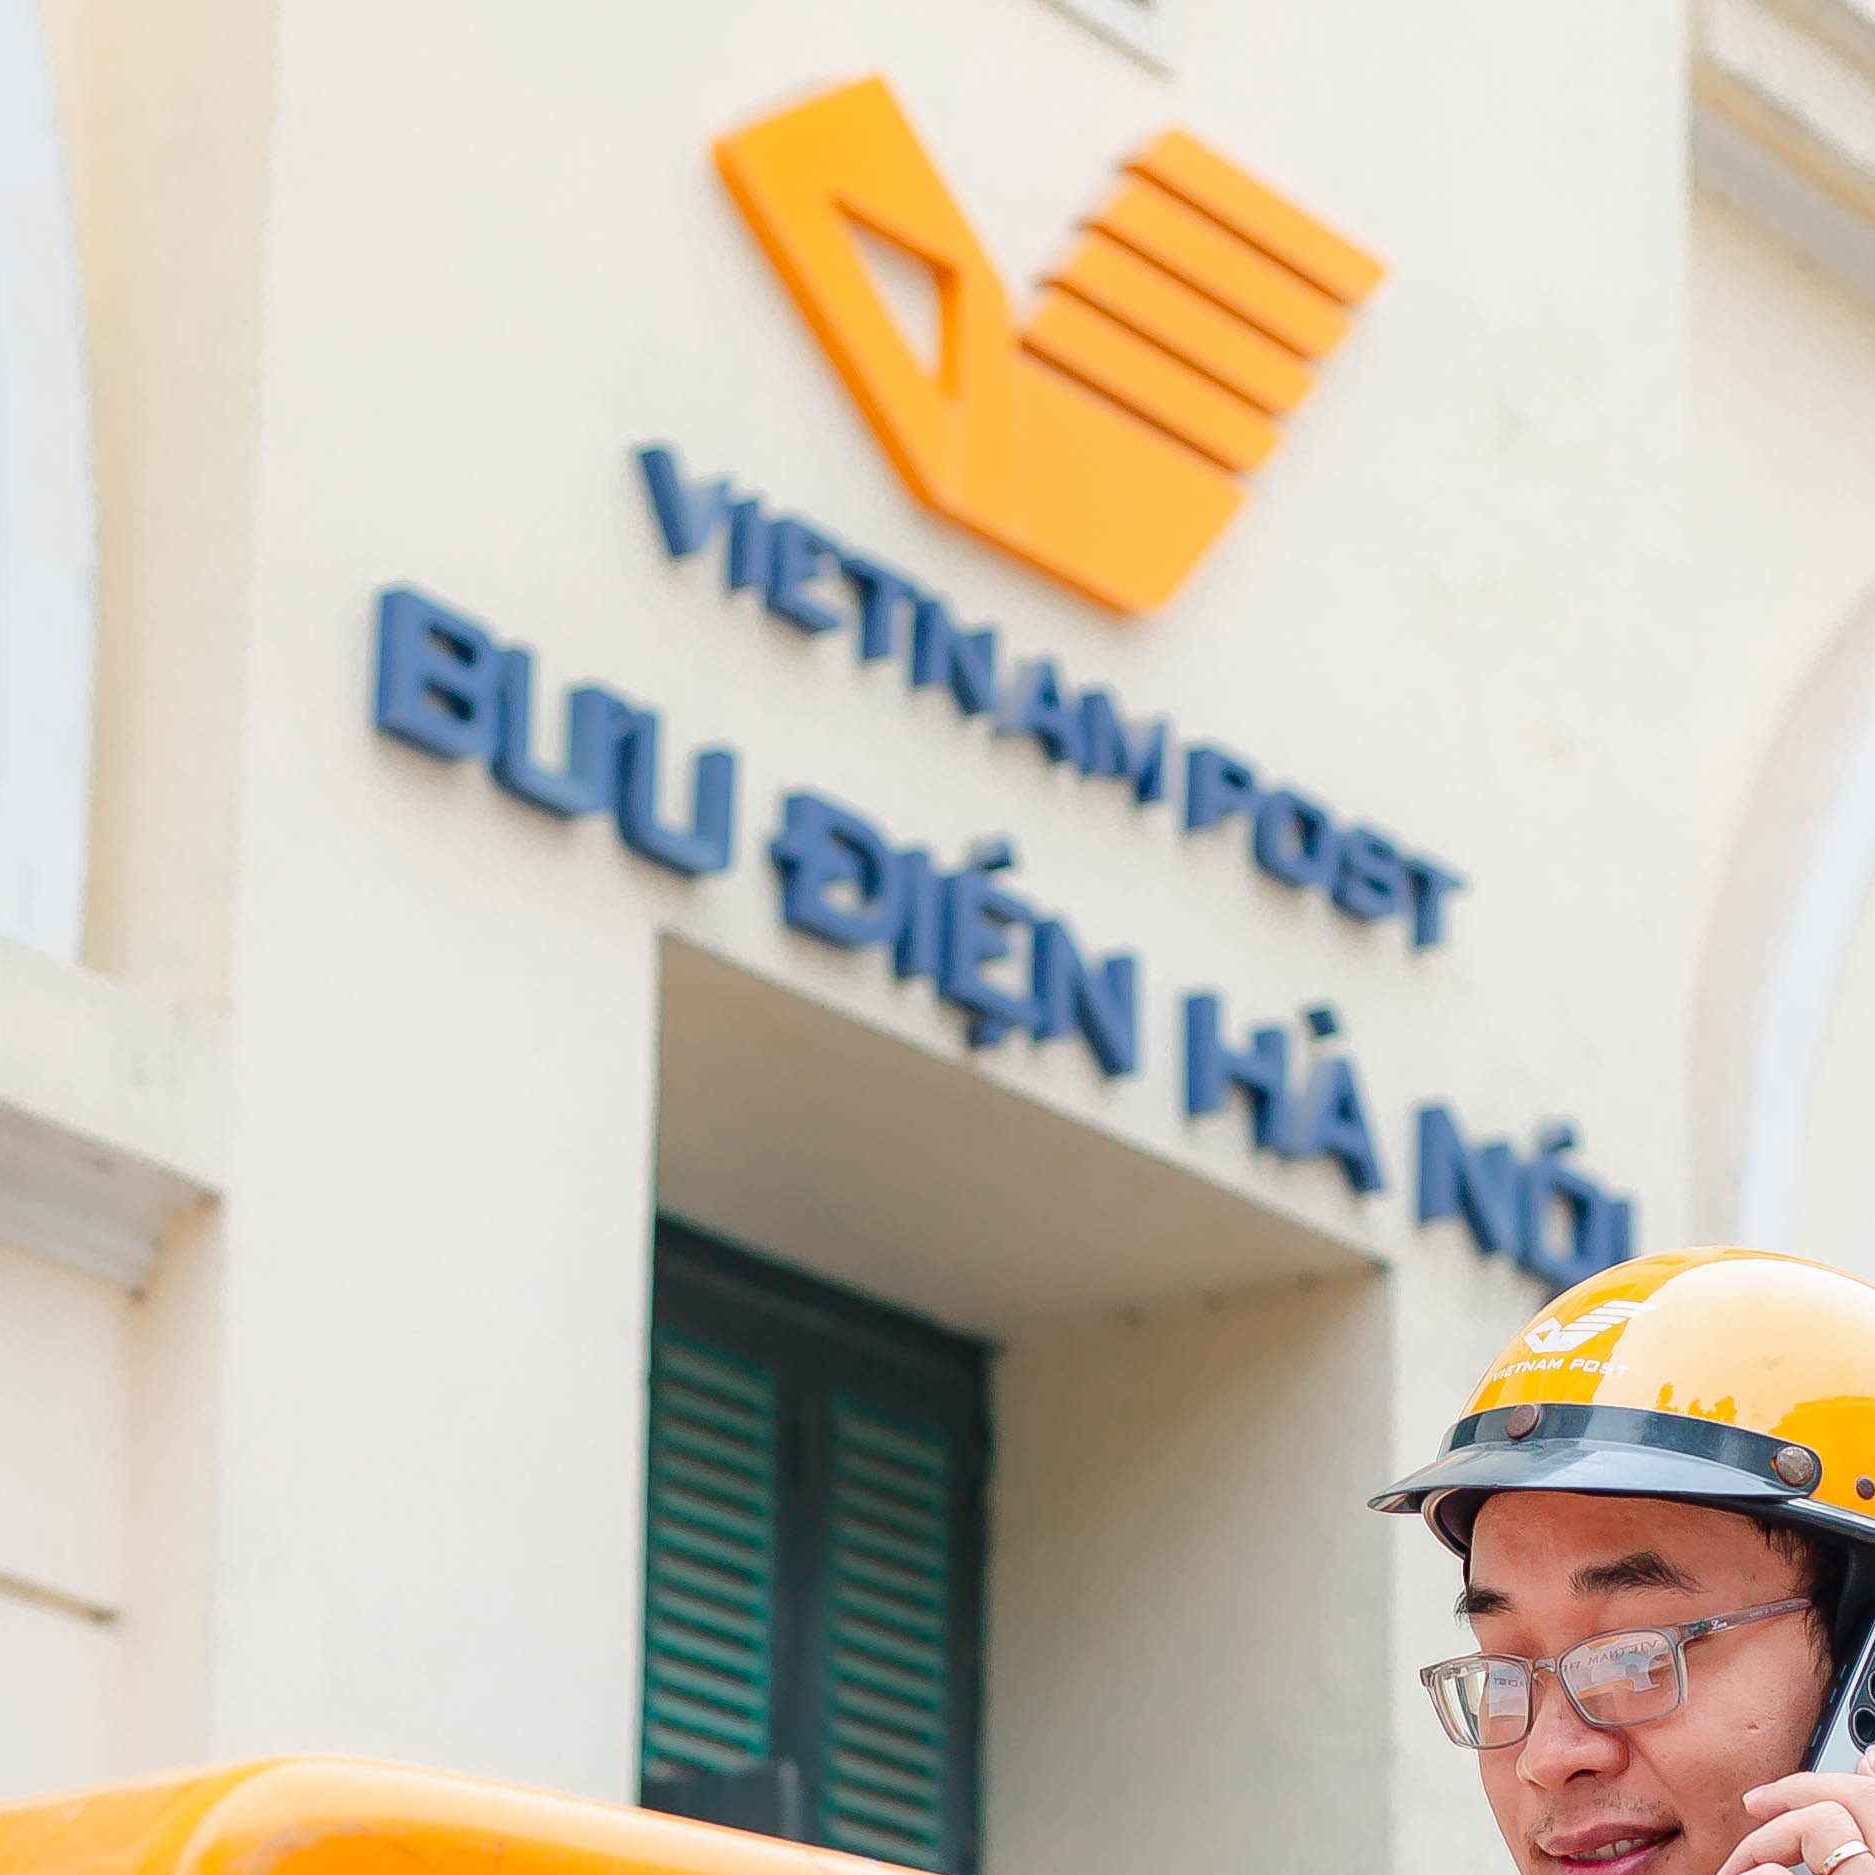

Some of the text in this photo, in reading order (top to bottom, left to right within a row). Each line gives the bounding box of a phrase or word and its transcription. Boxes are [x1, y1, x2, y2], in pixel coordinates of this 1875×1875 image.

[635, 442, 1466, 951] VIETNAM POST
[1181, 990, 1389, 1196] HÀ
[1492, 1357, 1630, 1382] VIETNAM POST
